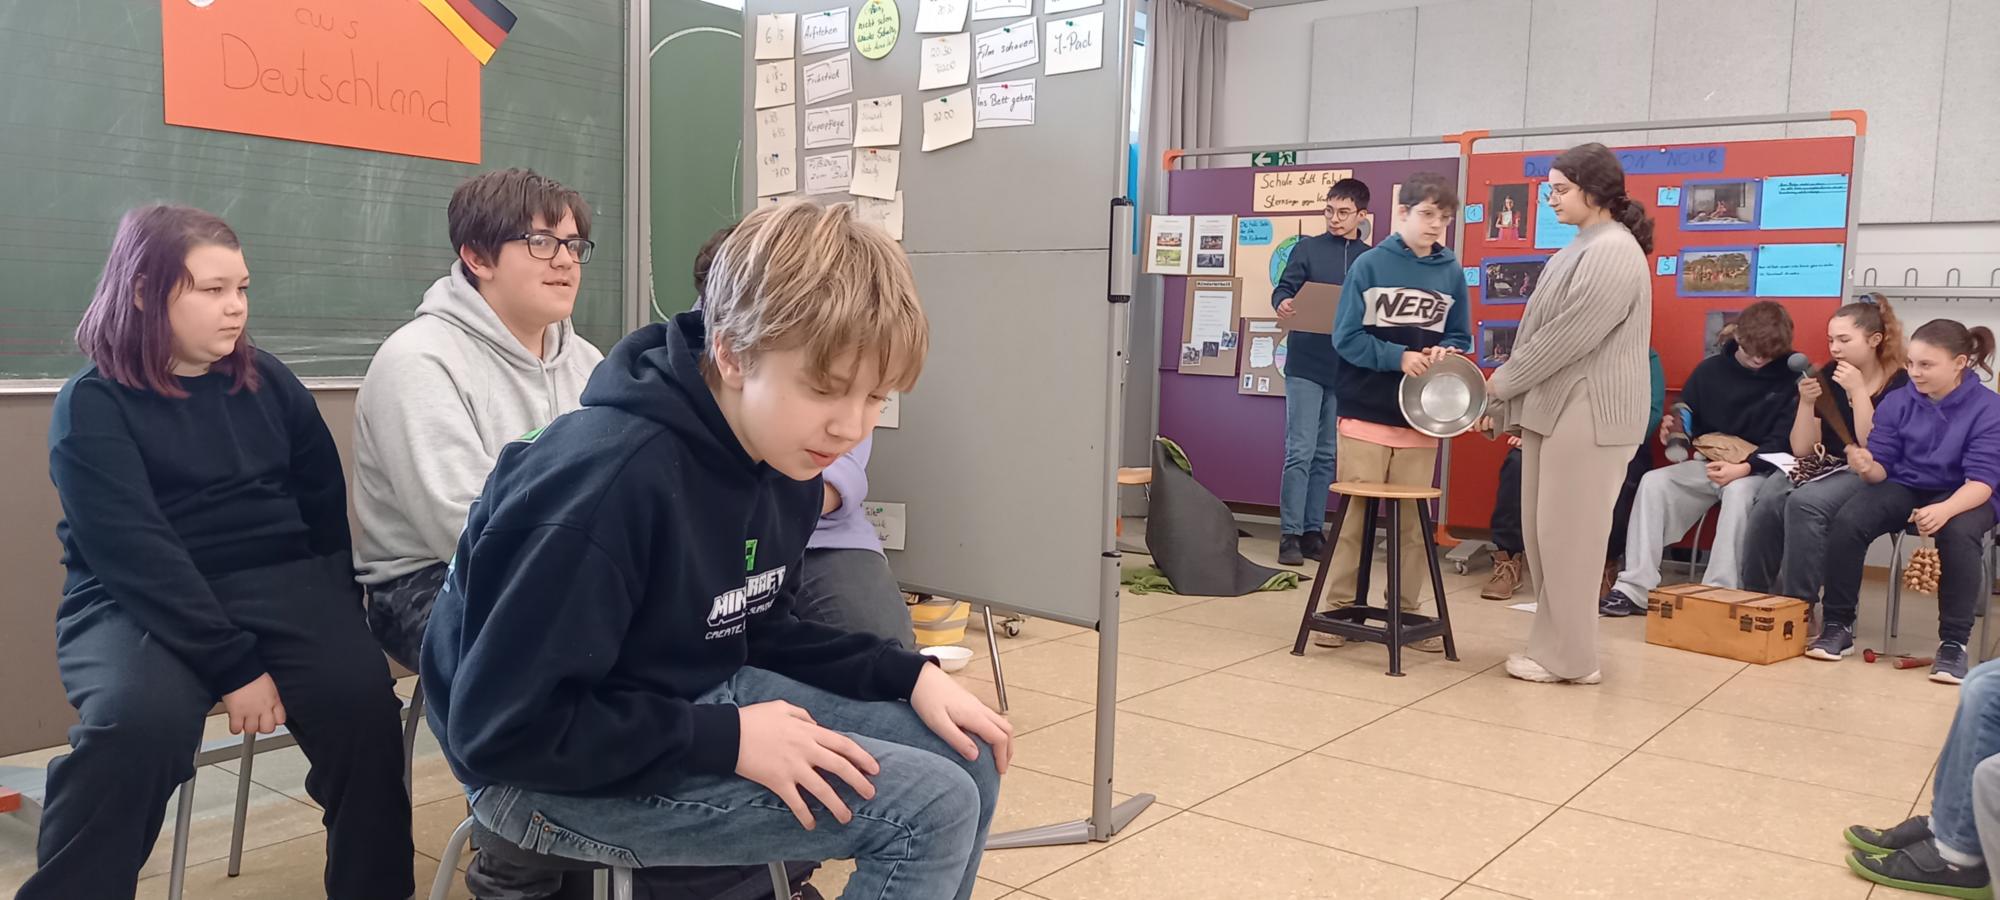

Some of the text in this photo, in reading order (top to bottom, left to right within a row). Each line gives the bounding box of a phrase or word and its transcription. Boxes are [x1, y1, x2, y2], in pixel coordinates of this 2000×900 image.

[976, 43, 994, 59] Film
[221, 32, 452, 127] Deutschland
[990, 93, 1008, 107] Bett
[1009, 93, 1034, 112] gehen
[1260, 172, 1292, 189] Schule
[1298, 172, 1316, 186] statt
[1376, 292, 1448, 320] NERF
